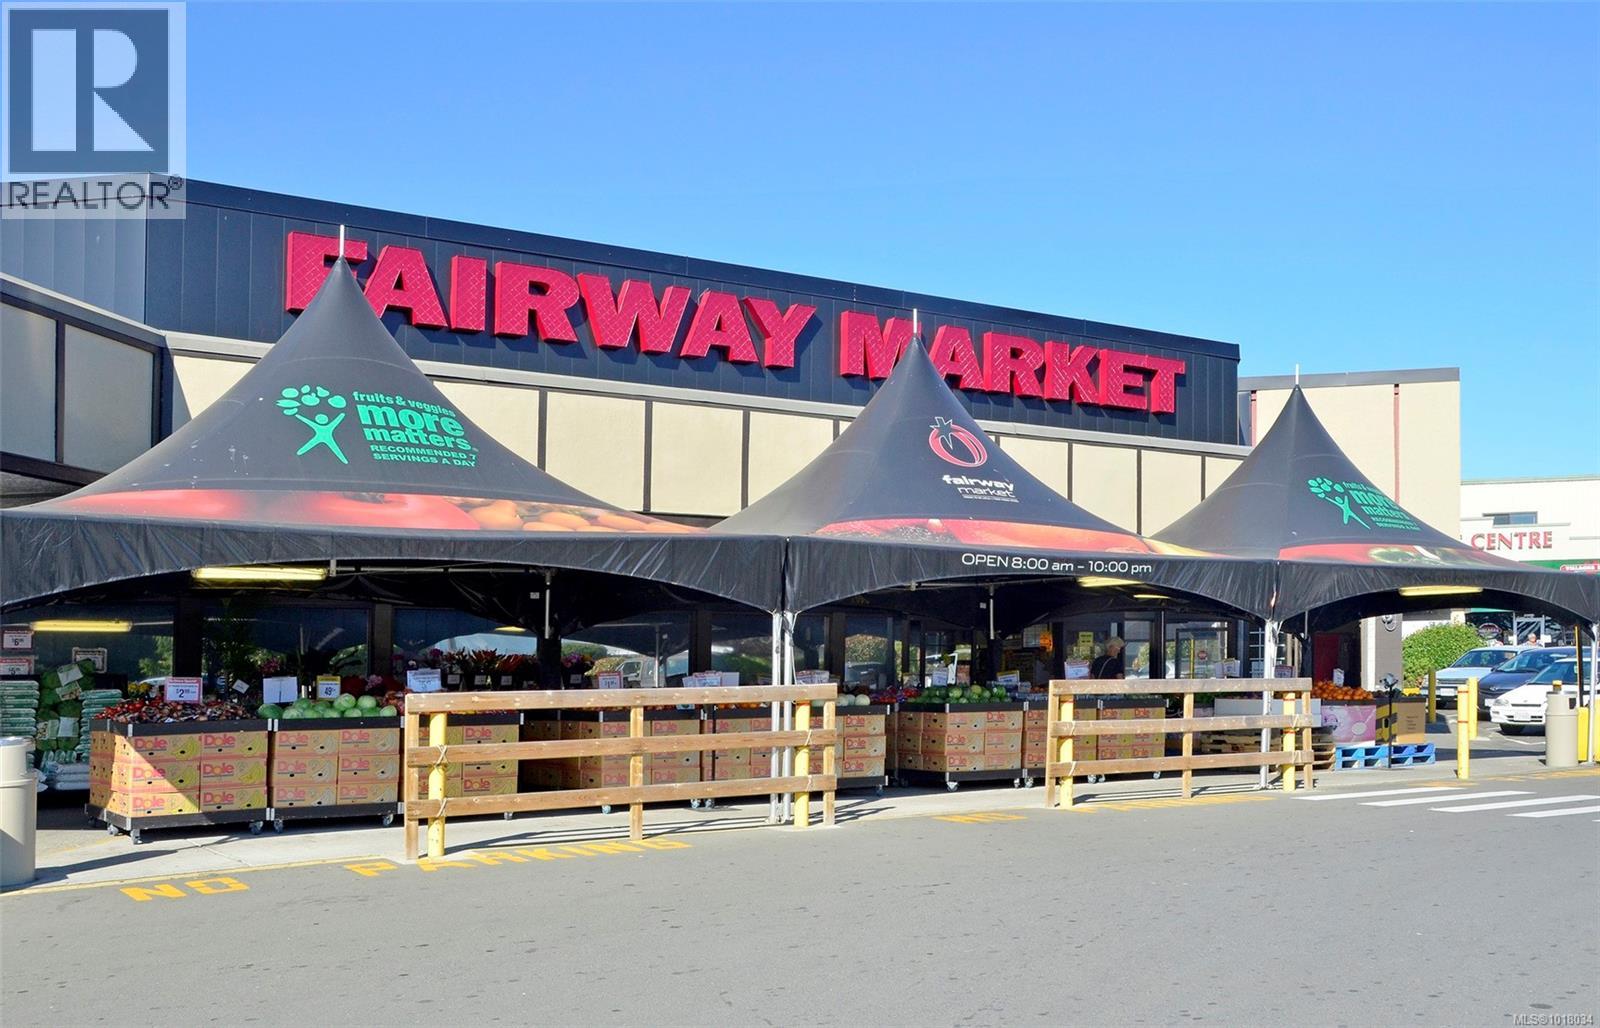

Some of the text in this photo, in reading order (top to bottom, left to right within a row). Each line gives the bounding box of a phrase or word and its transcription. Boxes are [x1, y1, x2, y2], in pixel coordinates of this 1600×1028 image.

[286, 231, 1186, 414] FAIRWAY MARKET
[353, 391, 457, 418] fruits & veggies
[356, 404, 465, 437] more
[370, 445, 466, 459] RECOMMENDED
[373, 453, 438, 463] SERVINGS
[453, 458, 476, 468] DAY
[942, 475, 1014, 491] fairway
[958, 486, 1016, 498] market
[1471, 531, 1553, 551] CENTRE
[961, 553, 1008, 568] OPEN
[1011, 558, 1049, 570] 8:00
[1051, 563, 1074, 571] am
[1088, 561, 1128, 573] 10:00
[1131, 564, 1152, 575] pm
[845, 716, 865, 725] Dole
[987, 712, 1006, 721] Dole
[279, 733, 308, 743] Dole
[342, 730, 369, 740] Dole
[465, 727, 492, 738] Dole
[135, 737, 167, 749] Dole
[203, 734, 236, 746] Dole
[846, 739, 866, 748] Dole
[947, 735, 966, 744] Dole
[278, 761, 306, 771] Dole
[341, 758, 369, 768] Dole
[844, 761, 864, 770] Dole
[949, 757, 967, 765] Dole
[133, 766, 166, 779] Dole
[203, 763, 235, 775] Dole
[464, 779, 490, 789] Dole
[132, 795, 165, 808] Dole
[203, 792, 235, 804] Dole
[120, 838, 691, 902] NO PARKING
